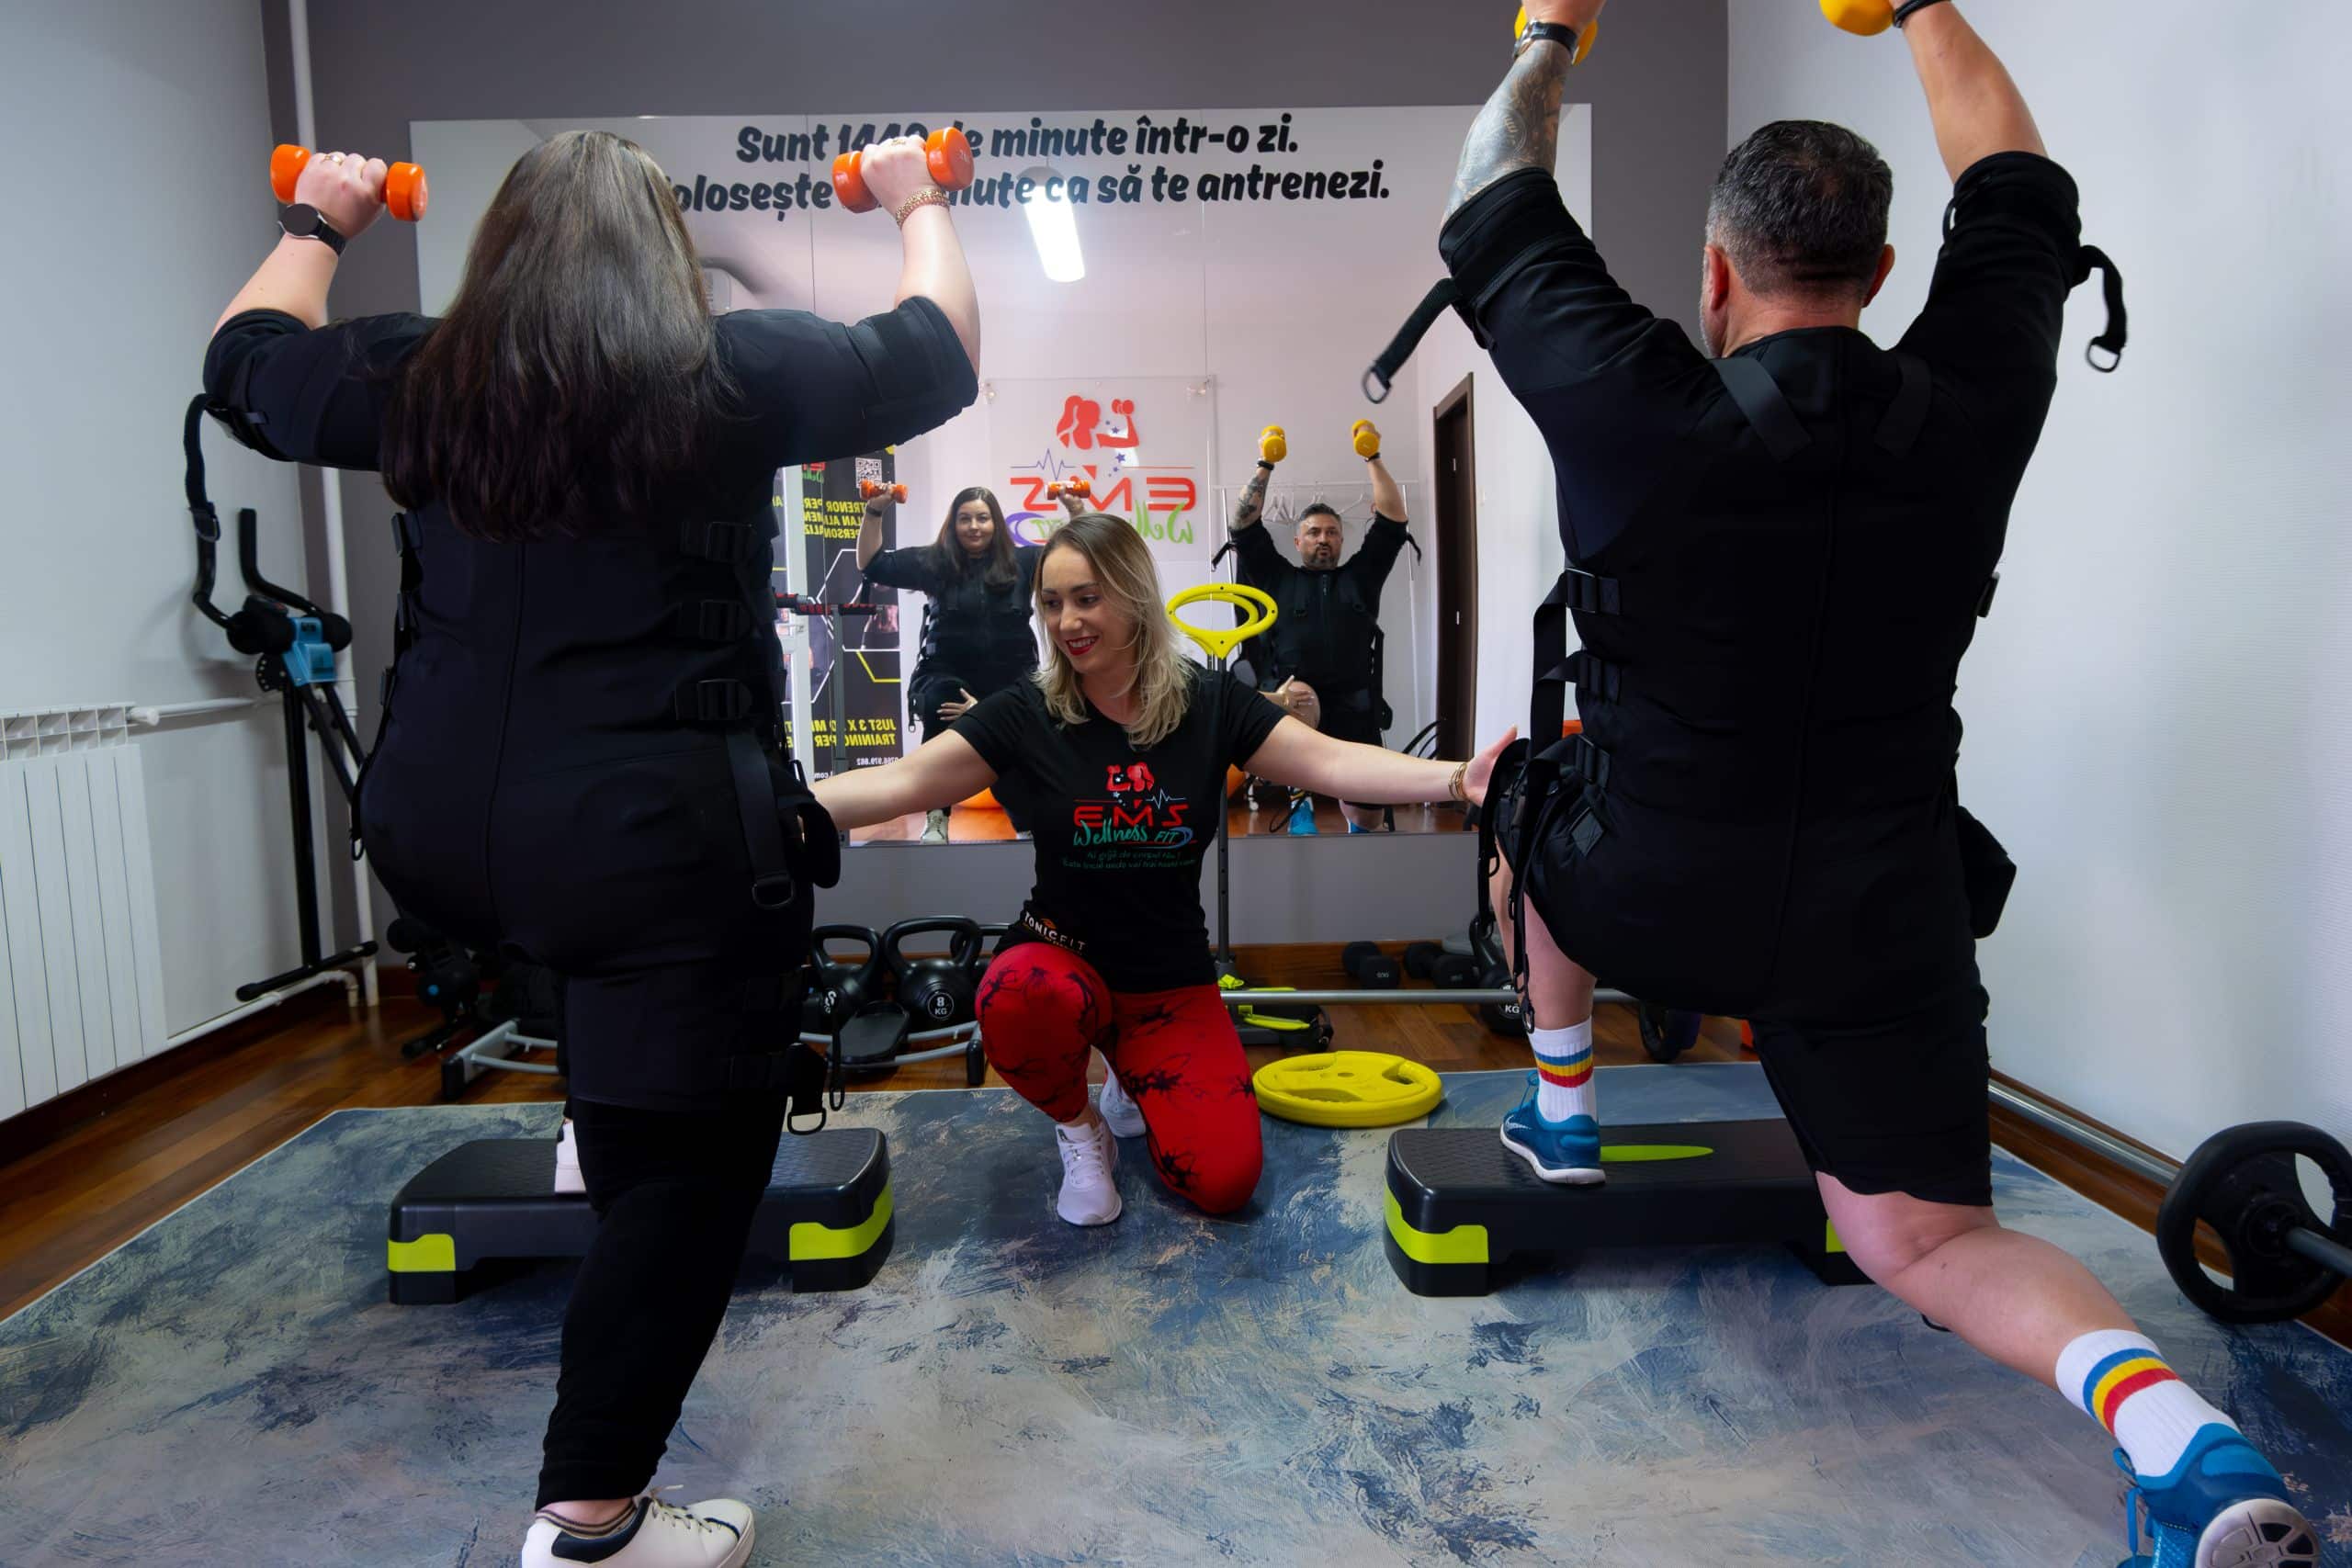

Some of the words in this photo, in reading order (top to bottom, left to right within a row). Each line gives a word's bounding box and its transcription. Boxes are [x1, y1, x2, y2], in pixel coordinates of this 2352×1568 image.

[736, 124, 830, 163] Sunt
[990, 117, 1128, 157] minute
[1136, 115, 1250, 155] într-o
[1257, 112, 1298, 153] zi.
[666, 172, 833, 222] olosește
[1045, 175, 1090, 203] ca
[1097, 164, 1143, 204] să
[1151, 165, 1190, 202] te
[1196, 159, 1389, 201] antrenezi.
[1073, 804, 1189, 828] EMS
[1073, 818, 1148, 847] Wellness
[1154, 830, 1180, 843] FIT
[933, 1007, 948, 1015] KG
[935, 996, 946, 1007] 8
[1505, 1004, 1520, 1014] KG
